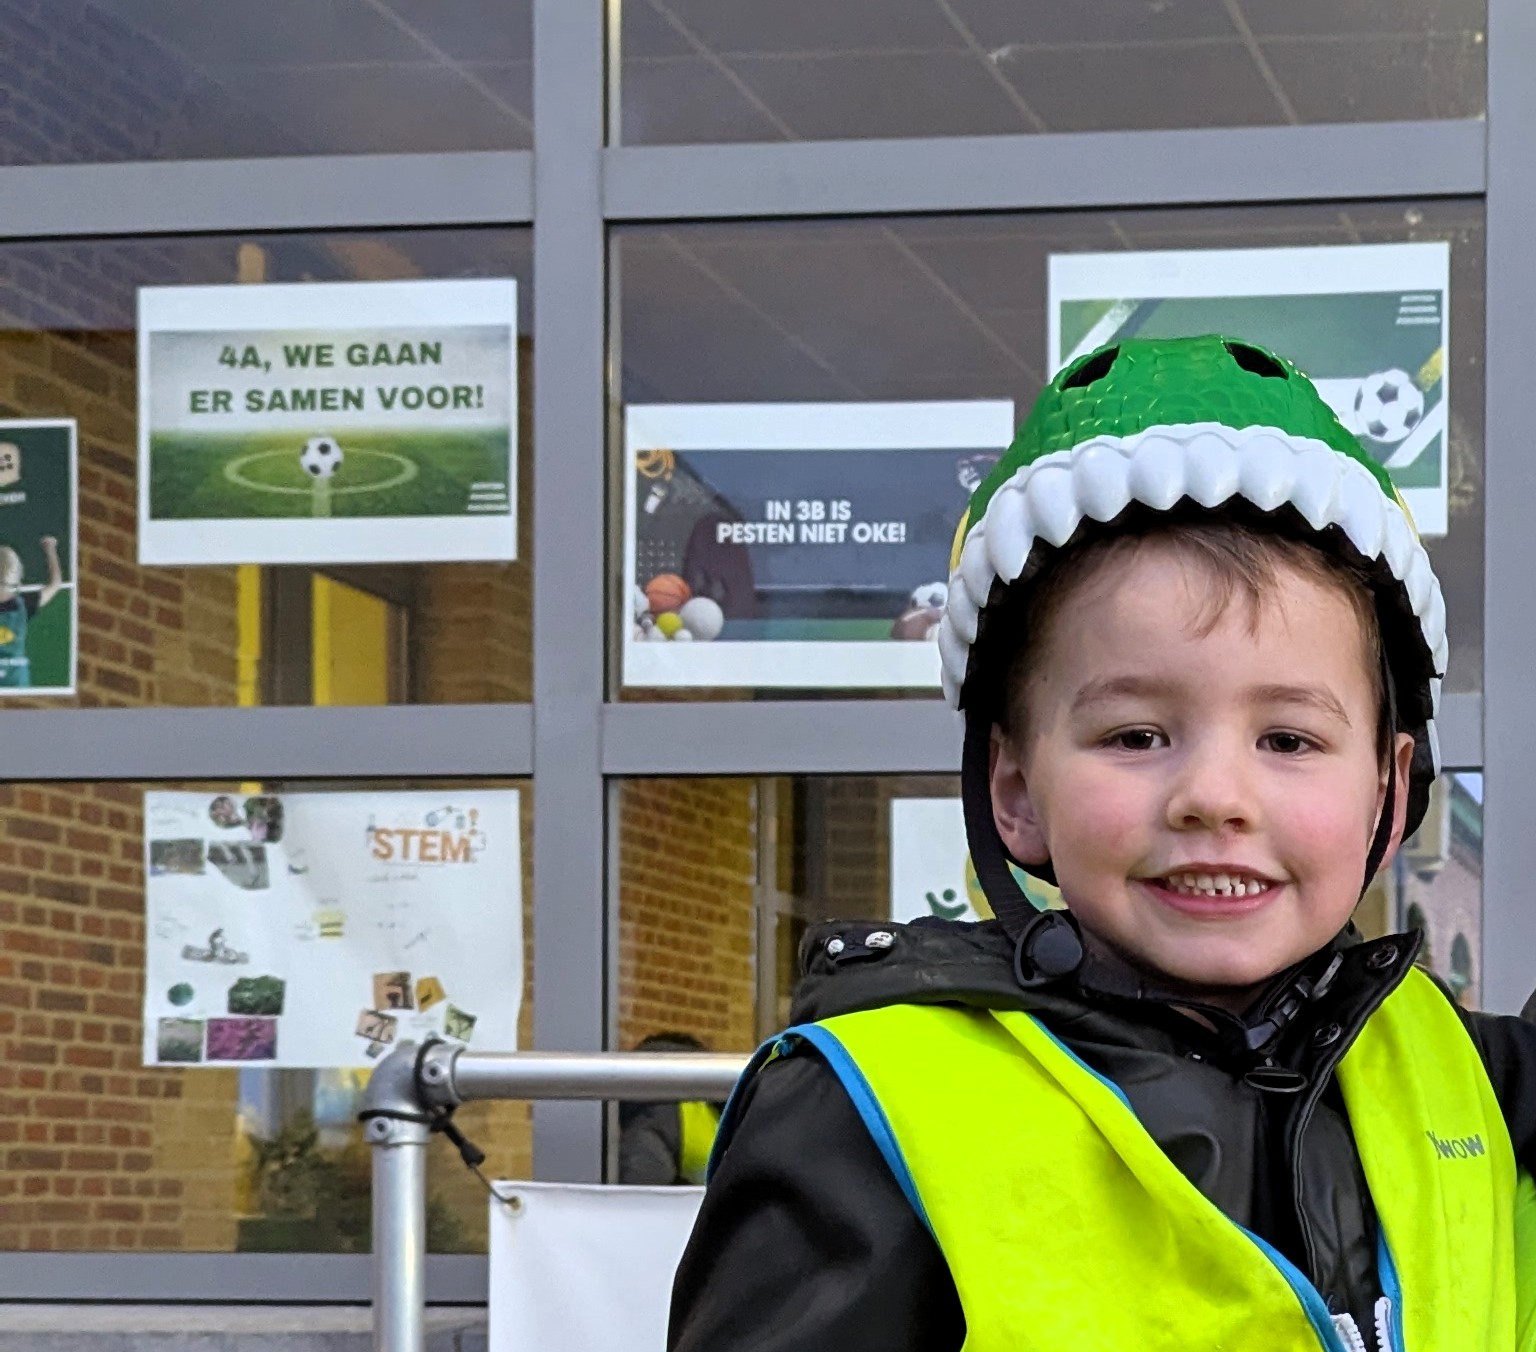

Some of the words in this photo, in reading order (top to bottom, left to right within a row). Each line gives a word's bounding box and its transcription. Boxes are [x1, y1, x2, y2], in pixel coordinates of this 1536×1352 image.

[218, 345, 271, 373] 4A,
[283, 344, 334, 368] WE
[345, 341, 443, 367] GAAN
[189, 389, 233, 413] ER
[245, 387, 365, 412] SAMEN
[376, 384, 484, 410] VOOR!
[766, 500, 791, 521] IN
[796, 500, 826, 521] 3B
[831, 500, 852, 521] IS
[716, 522, 795, 544] PESTEN
[800, 522, 848, 543] NIET
[853, 521, 907, 543] OKE!
